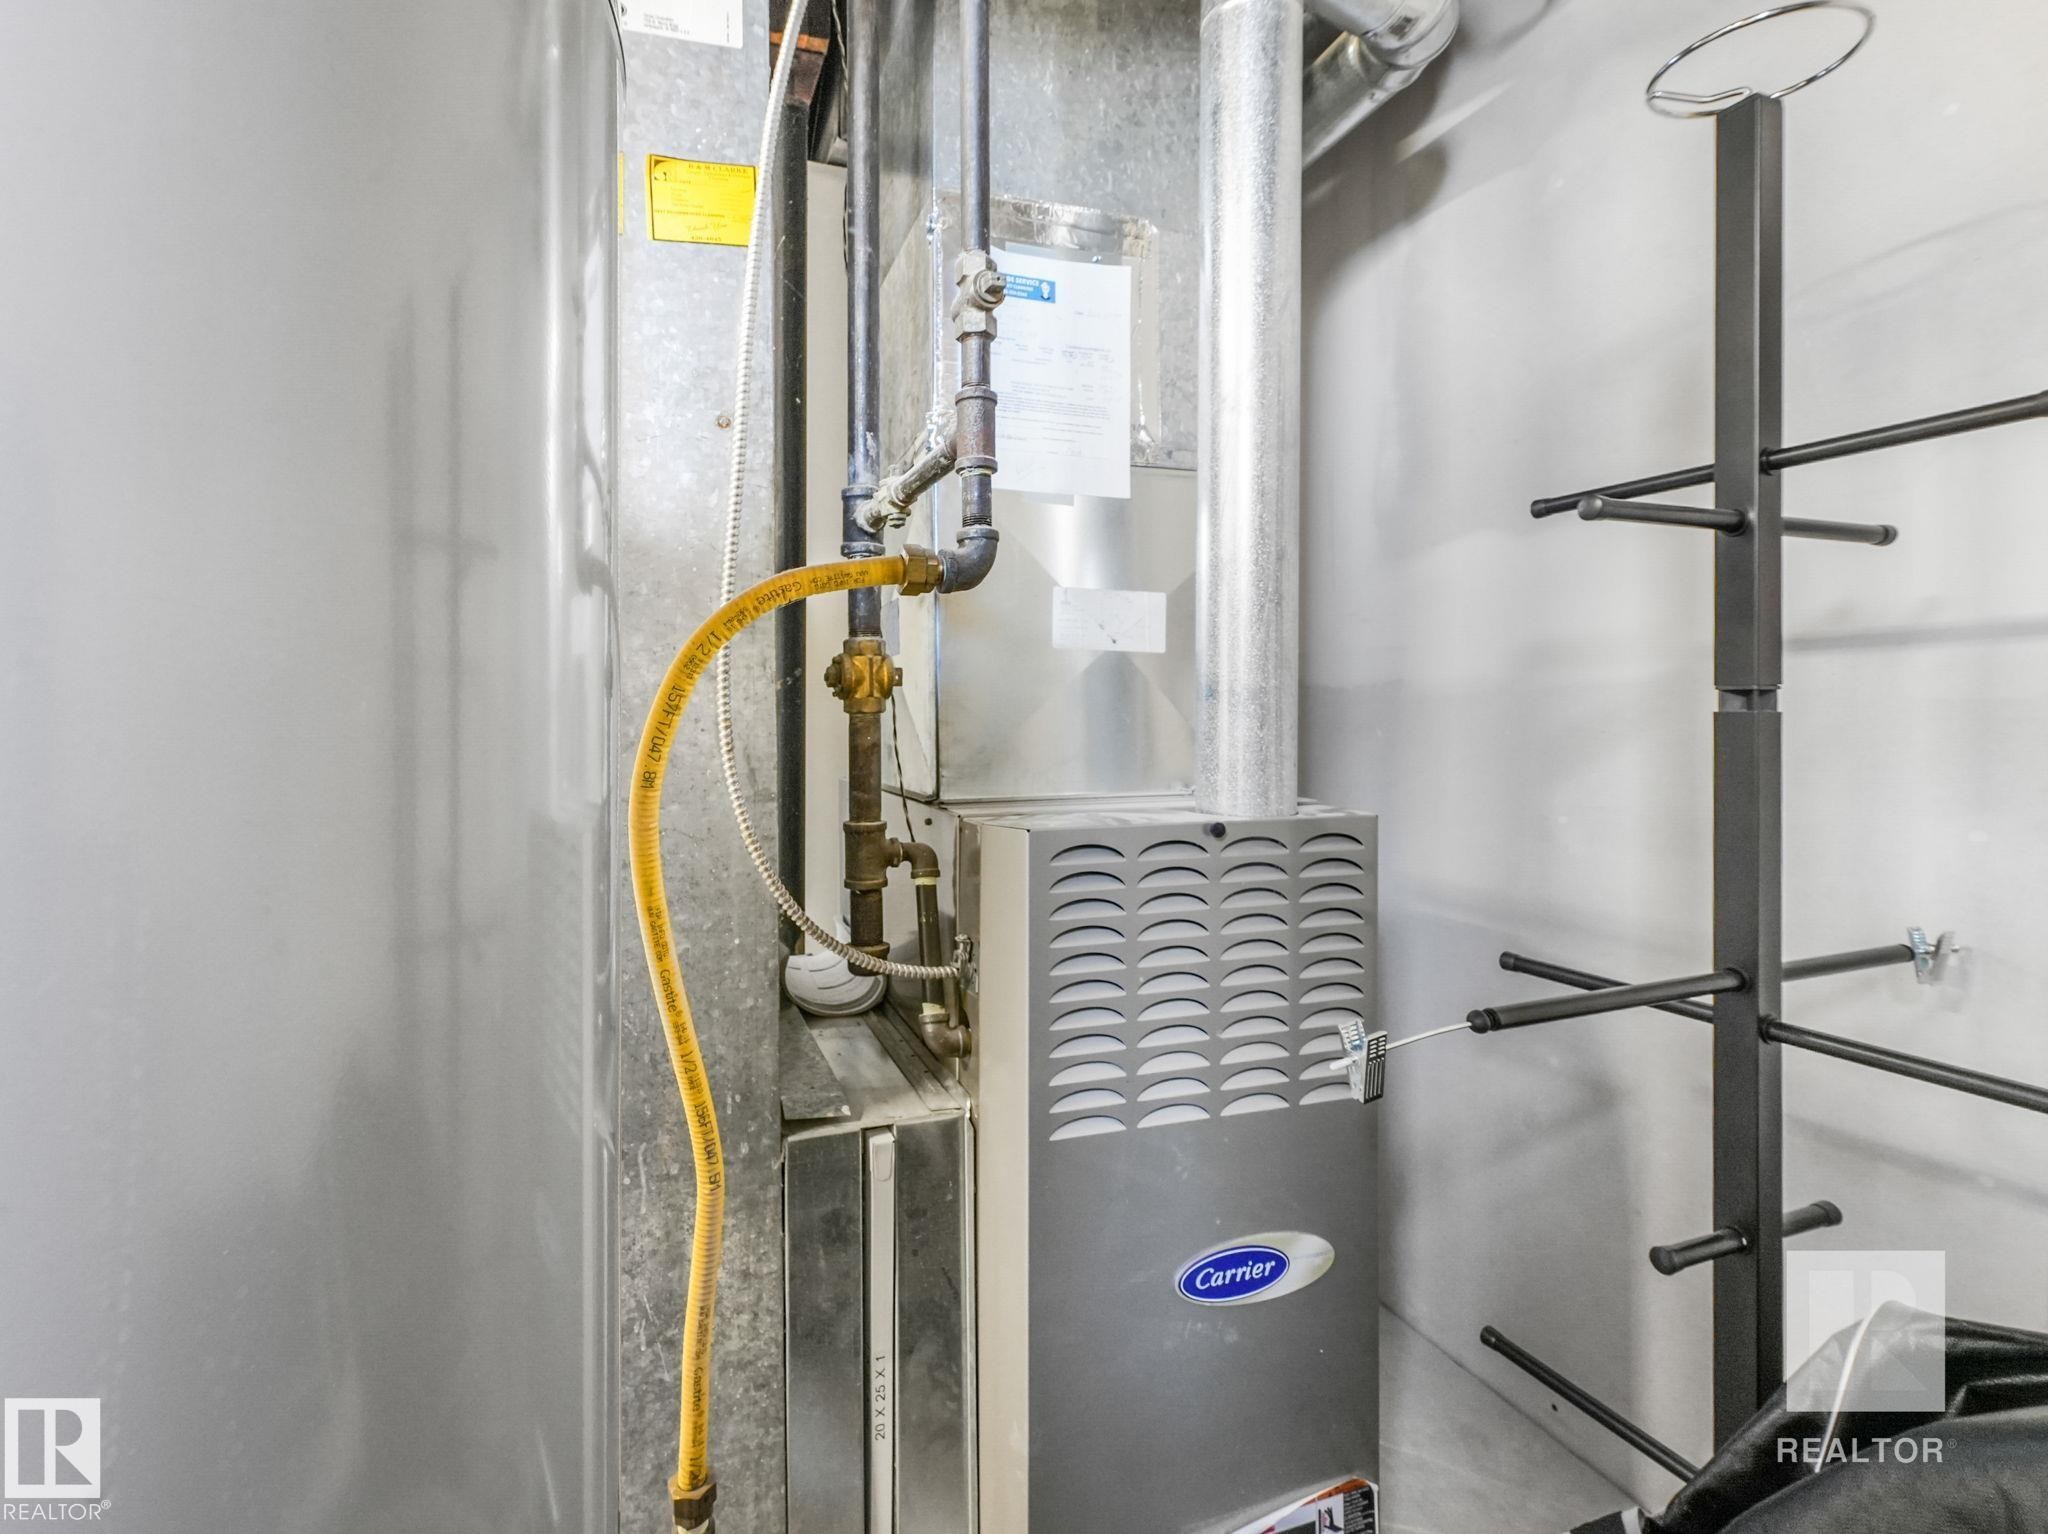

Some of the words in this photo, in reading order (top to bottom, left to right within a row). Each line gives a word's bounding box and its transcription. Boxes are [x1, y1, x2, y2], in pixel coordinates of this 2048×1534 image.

[1016, 277, 1039, 287] SERVICE
[696, 630, 721, 658] 1/2
[680, 1051, 698, 1074] 1/2
[1195, 1260, 1276, 1290] Carrier
[875, 1367, 886, 1379] X
[875, 1384, 886, 1402] 25
[875, 1406, 886, 1418] X
[875, 1423, 886, 1440] 20
